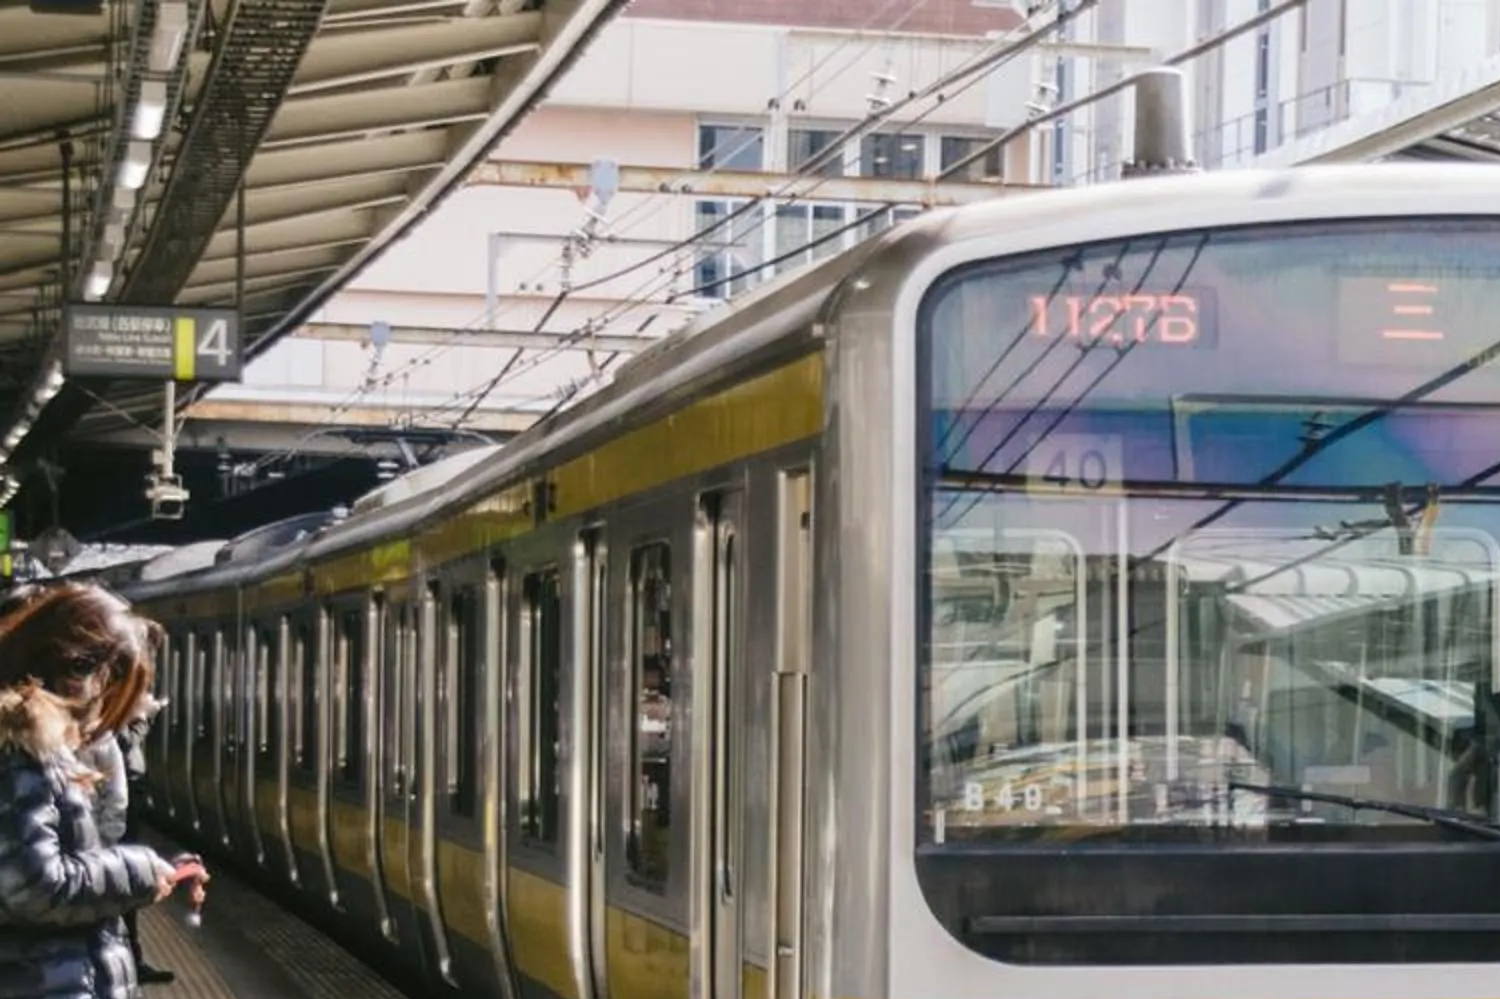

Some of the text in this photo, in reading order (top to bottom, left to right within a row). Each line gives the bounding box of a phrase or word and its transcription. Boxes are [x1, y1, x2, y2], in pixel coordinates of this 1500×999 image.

[197, 318, 233, 366] 4
[1029, 294, 1199, 343] 1127B
[1042, 449, 1108, 490] 40
